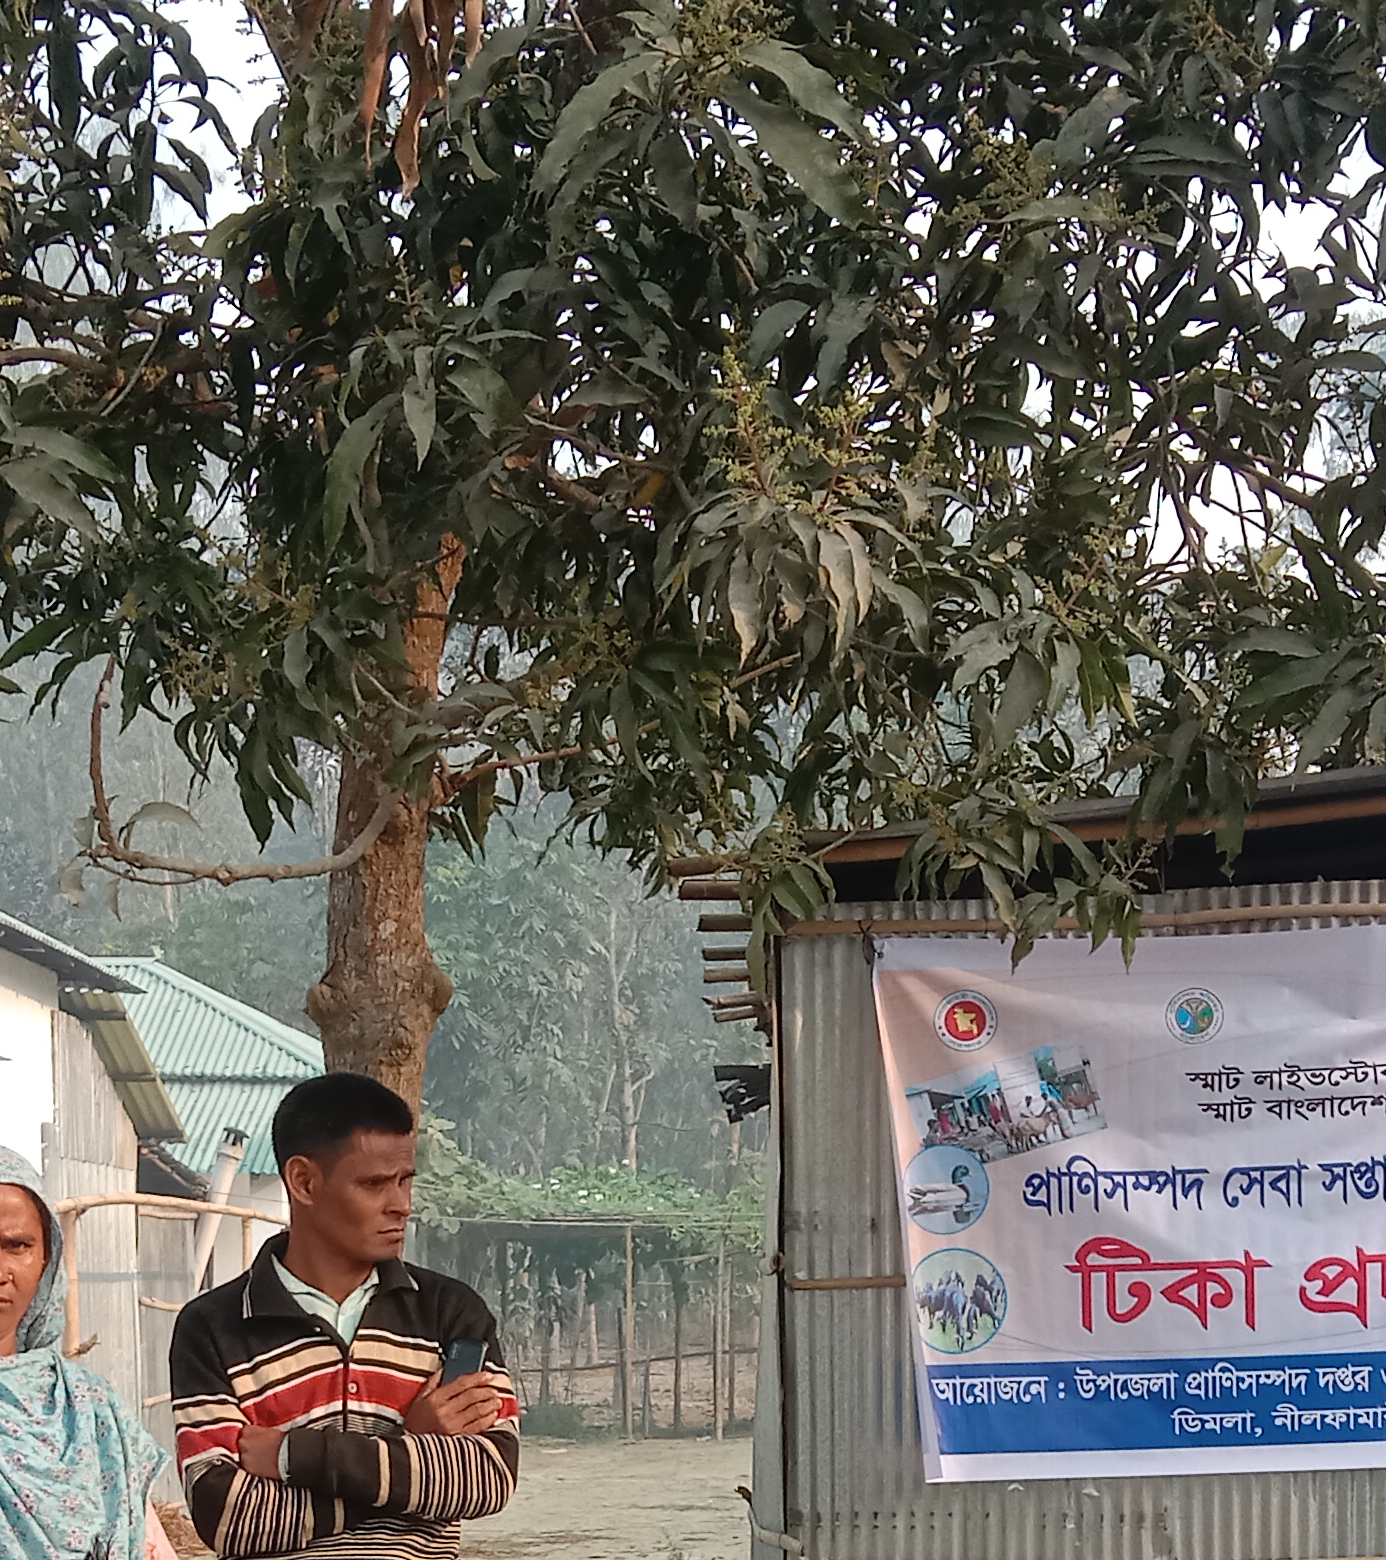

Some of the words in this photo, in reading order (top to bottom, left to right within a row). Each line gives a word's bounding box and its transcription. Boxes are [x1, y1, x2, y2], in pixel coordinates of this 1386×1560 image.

[1022, 1155, 1210, 1216] প্রাণিসম্পদ
[1222, 1158, 1310, 1208] সেবা
[1063, 1236, 1272, 1334] টিকা
[931, 1375, 1049, 1405] আয়োজনে
[1074, 1367, 1179, 1400] উপজেলা
[1184, 1362, 1310, 1400] প্রাণিসম্পদ
[1315, 1362, 1373, 1395] দপ্তর
[1171, 1407, 1264, 1438] ডিমলা,
